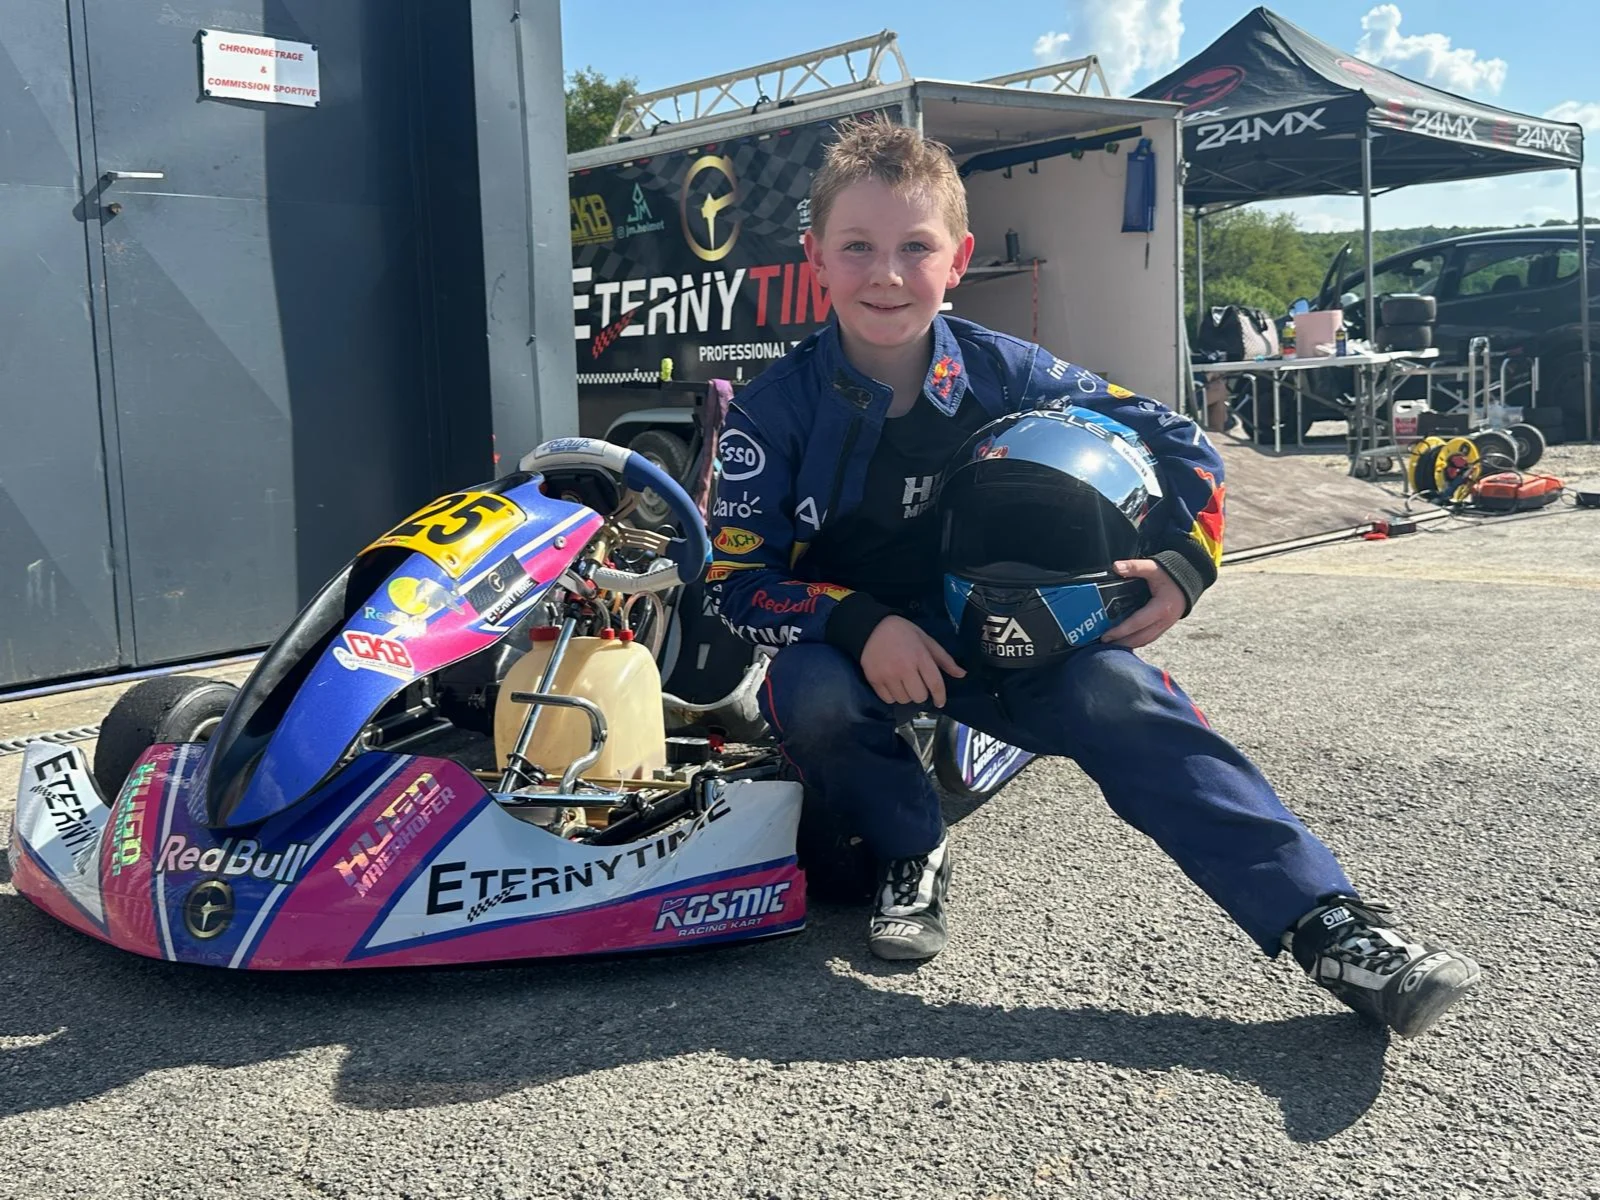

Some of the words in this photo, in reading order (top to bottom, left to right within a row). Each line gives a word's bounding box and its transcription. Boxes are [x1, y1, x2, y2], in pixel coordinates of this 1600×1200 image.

[259, 65, 267, 74] &
[207, 77, 271, 92] COMMISSION
[273, 84, 318, 97] SPORTIVE
[1195, 106, 1327, 152] 24MX
[1411, 108, 1479, 142] 24MX
[1515, 123, 1572, 155] 24MX
[699, 340, 787, 362] PROFESSIONAL
[383, 493, 508, 546] 25
[981, 614, 1033, 644] EA
[1067, 607, 1105, 645] BYBIT
[346, 633, 413, 669] CKB
[981, 643, 1035, 657] SPORTS
[353, 785, 457, 899] MAIERHOFER
[655, 882, 791, 931] KOSMIC
[677, 923, 728, 938] RACING
[730, 917, 764, 930] KART
